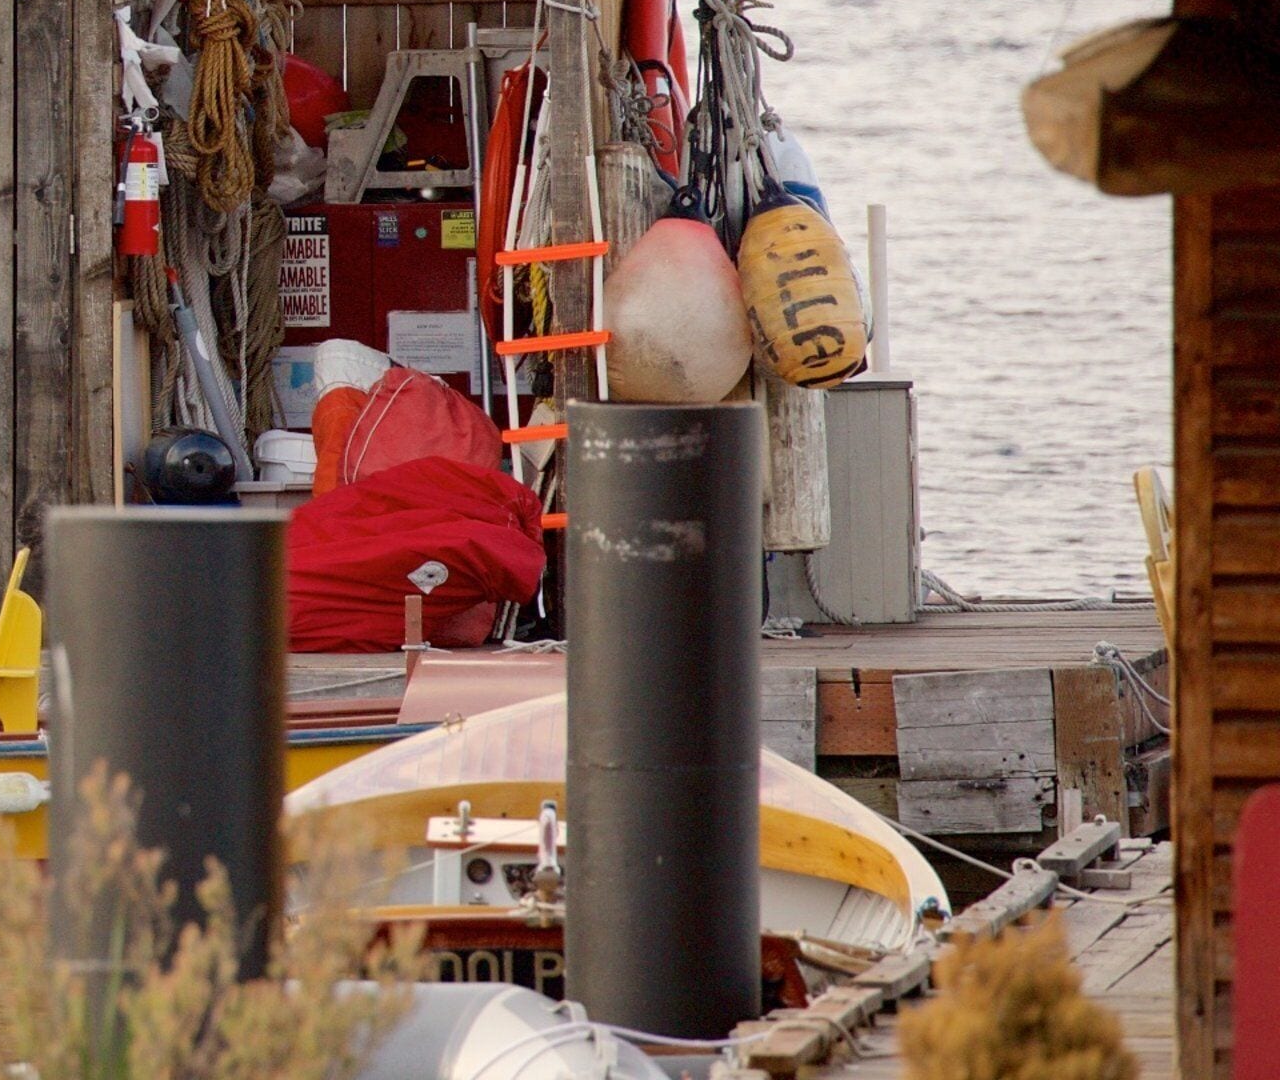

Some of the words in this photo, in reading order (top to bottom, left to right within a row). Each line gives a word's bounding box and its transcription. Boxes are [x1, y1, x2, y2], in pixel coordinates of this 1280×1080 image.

[282, 237, 327, 259] MABLE
[277, 266, 328, 287] AMABLE
[279, 295, 328, 316] MMABLE
